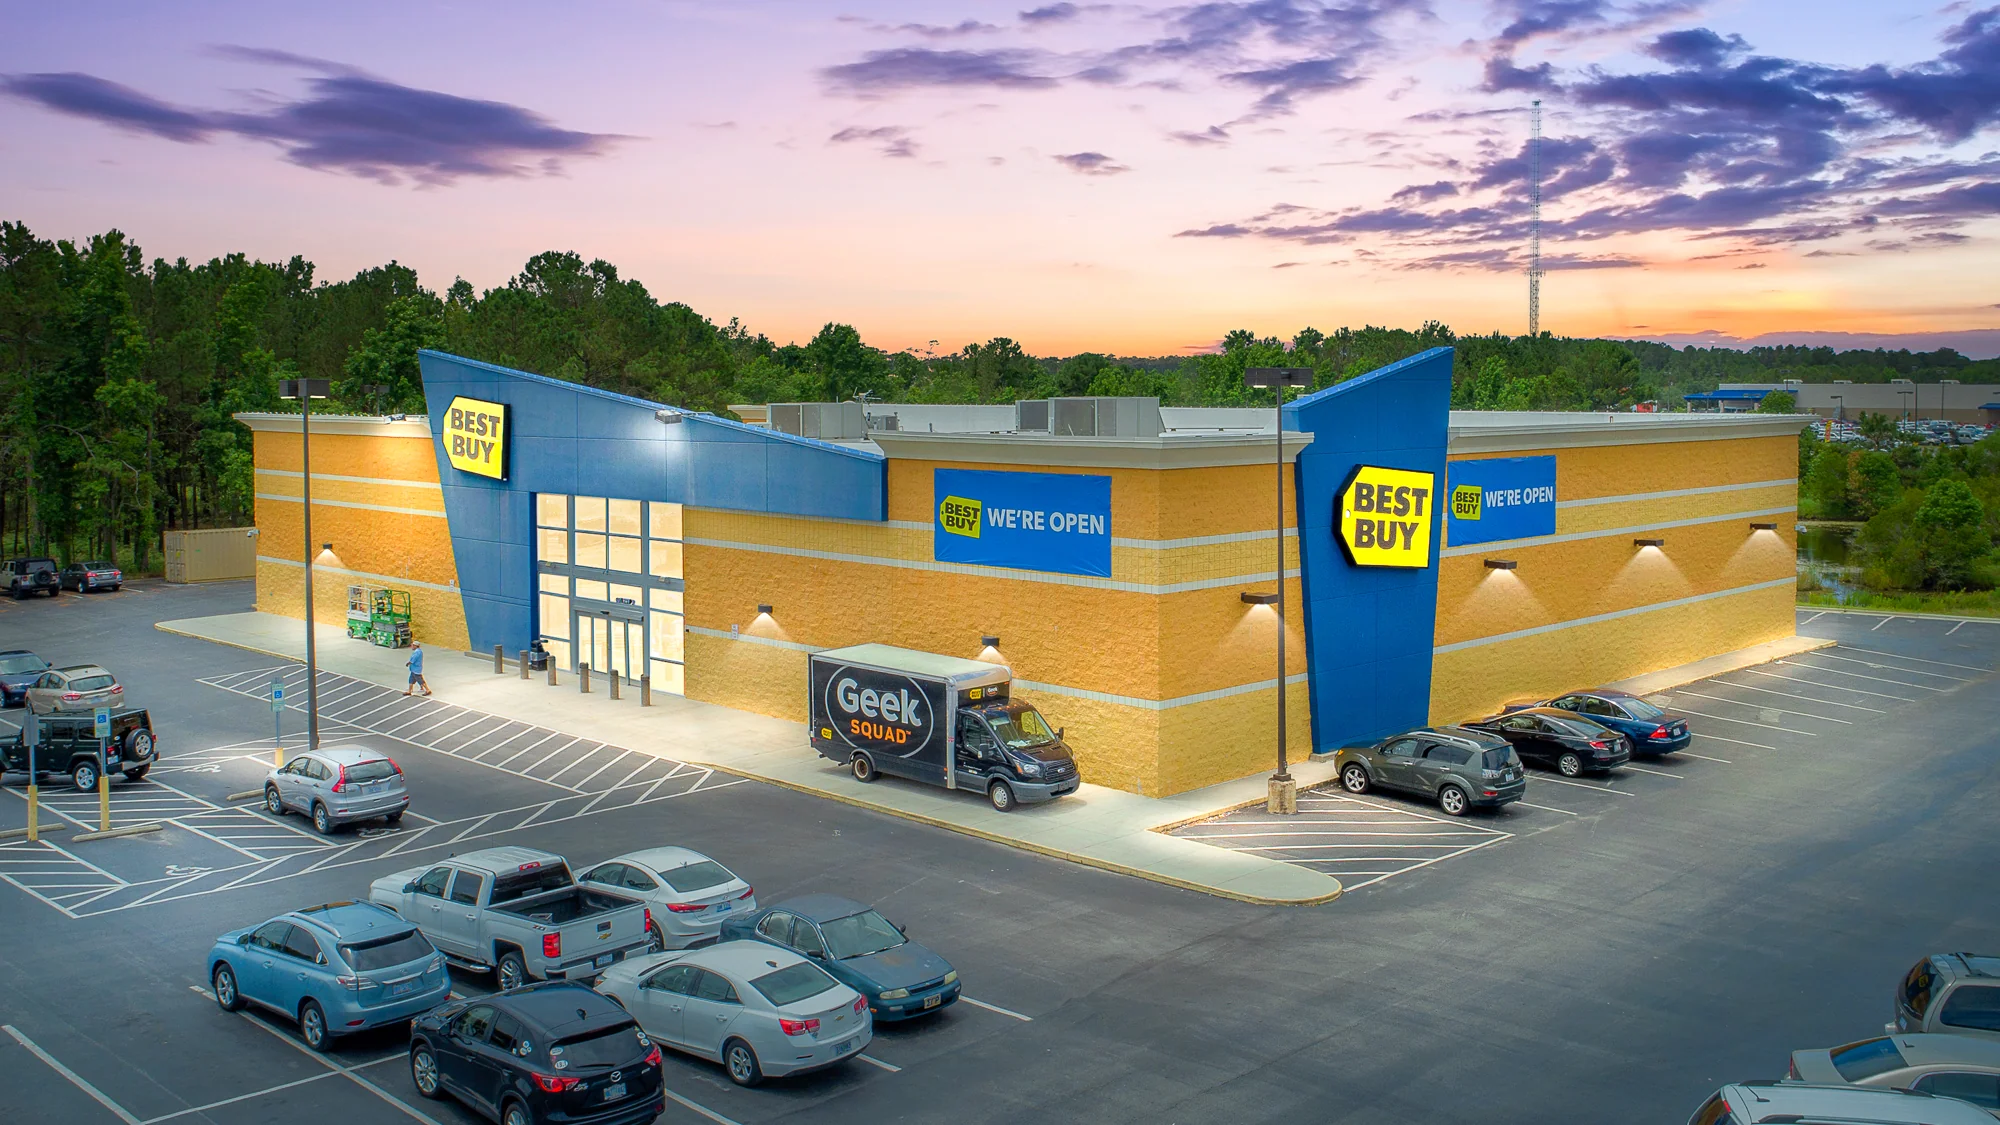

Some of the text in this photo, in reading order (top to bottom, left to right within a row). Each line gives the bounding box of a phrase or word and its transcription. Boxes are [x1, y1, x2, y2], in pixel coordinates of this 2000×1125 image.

[451, 408, 500, 437] BEST
[453, 434, 495, 464] BUY
[945, 502, 980, 520] BEST
[1354, 482, 1428, 517] BEST
[1456, 492, 1480, 503] BEST
[1456, 504, 1478, 514] BUY
[1485, 486, 1553, 508] WE'RE OPEN
[945, 515, 977, 531] BUY
[987, 507, 1104, 535] WE'RE OPEN
[1354, 519, 1419, 550] BUY
[837, 678, 922, 727] Geek
